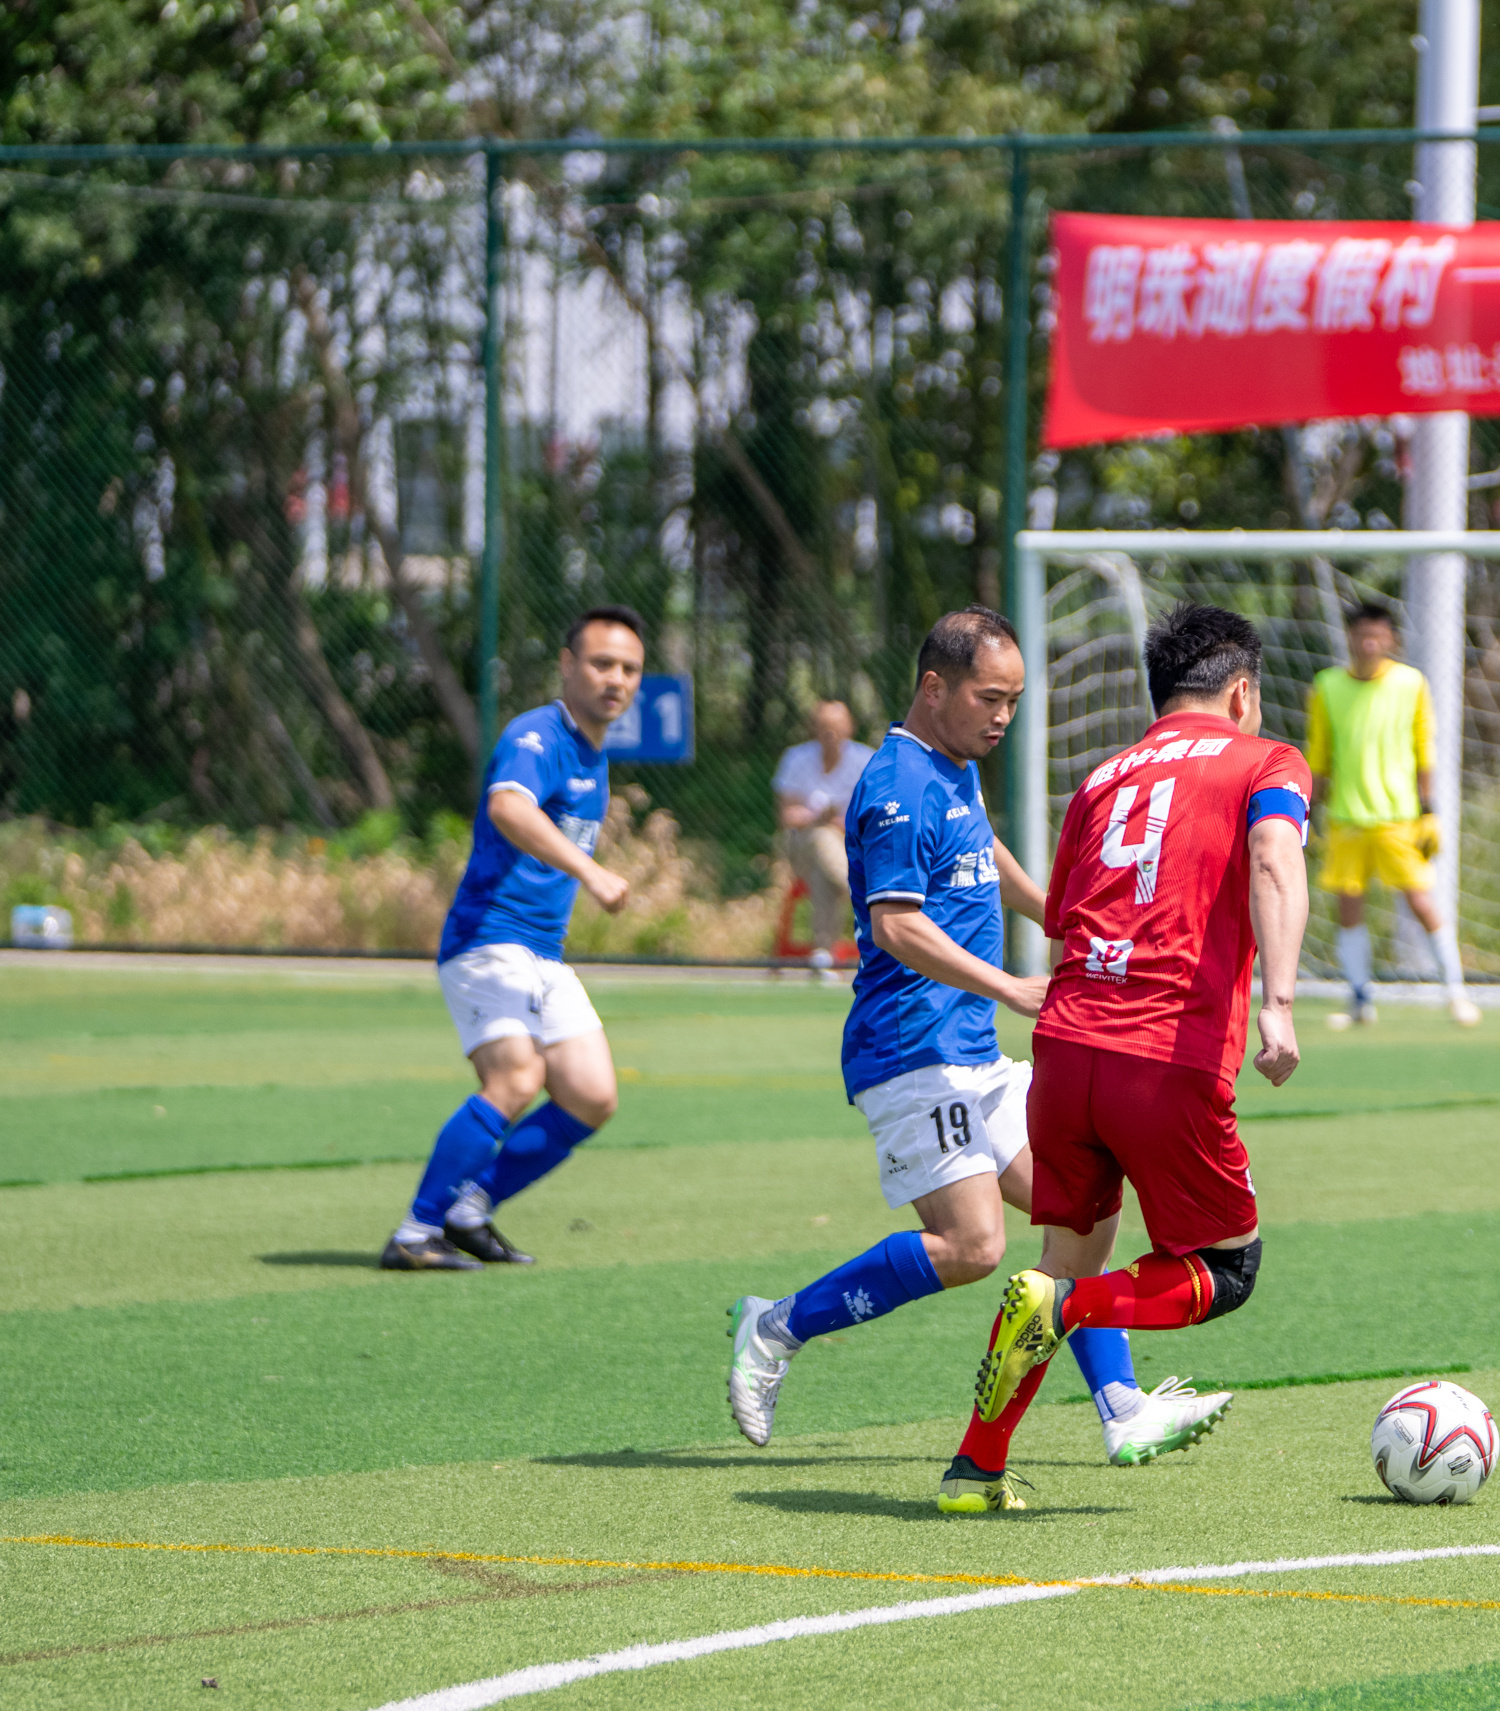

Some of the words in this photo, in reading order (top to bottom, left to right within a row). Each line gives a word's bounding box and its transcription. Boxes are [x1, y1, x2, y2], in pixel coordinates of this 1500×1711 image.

[878, 814, 911, 828] KELME
[1099, 777, 1176, 905] 4
[930, 1102, 972, 1154] 19
[1013, 1314, 1042, 1353] adidas
